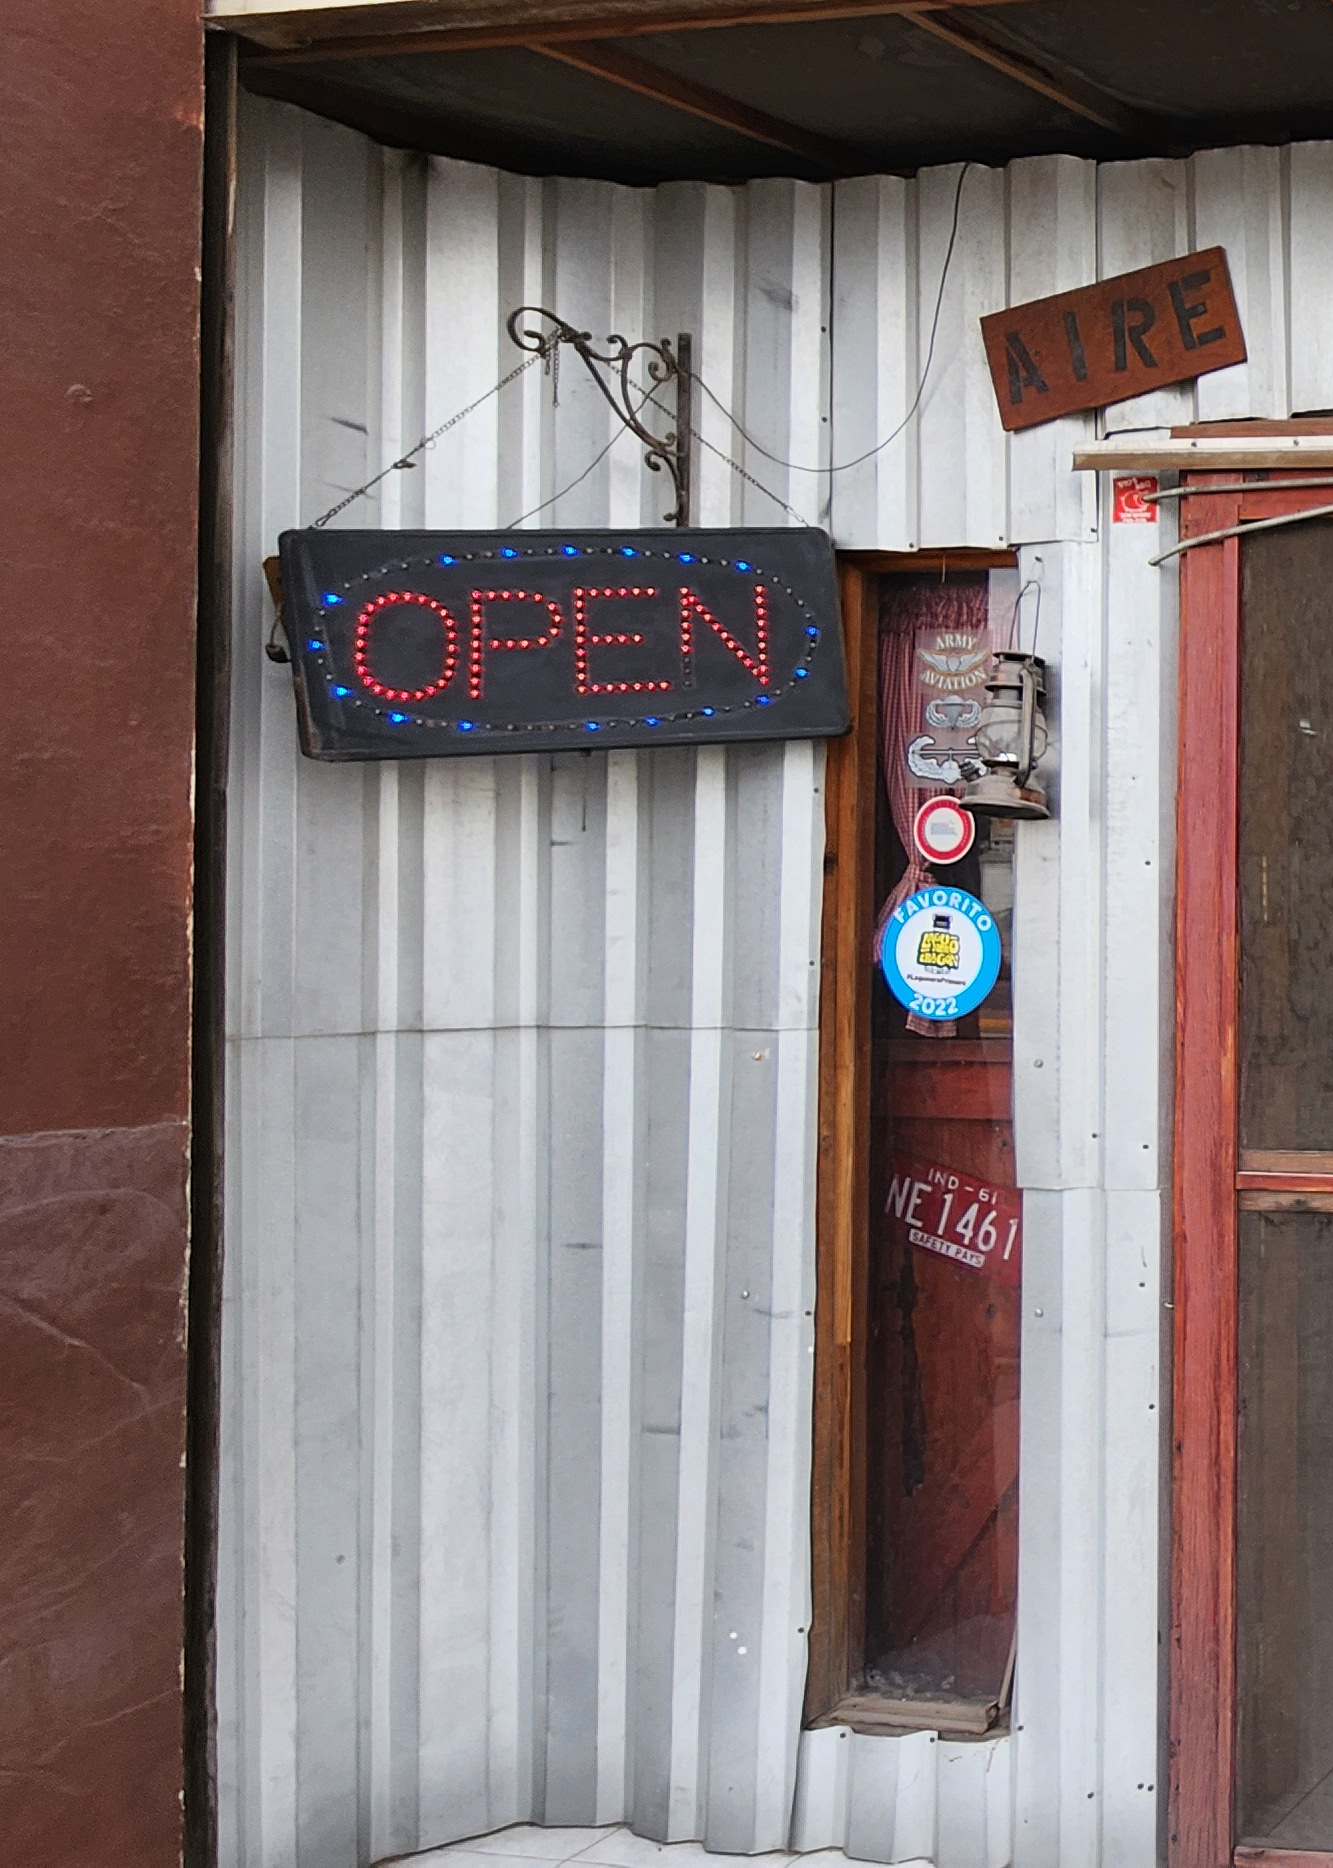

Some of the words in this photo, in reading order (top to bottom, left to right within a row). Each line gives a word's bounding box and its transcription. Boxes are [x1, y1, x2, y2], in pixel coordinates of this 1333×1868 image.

[1004, 269, 1227, 405] AIRE
[353, 583, 771, 701] OPEN
[935, 633, 977, 651] ARMY
[919, 668, 989, 691] AVIATION
[893, 889, 992, 932] FAVORITO
[908, 993, 960, 1017] 2022
[911, 1229, 951, 1254] SAFETY
[954, 1244, 984, 1267] PAYS
